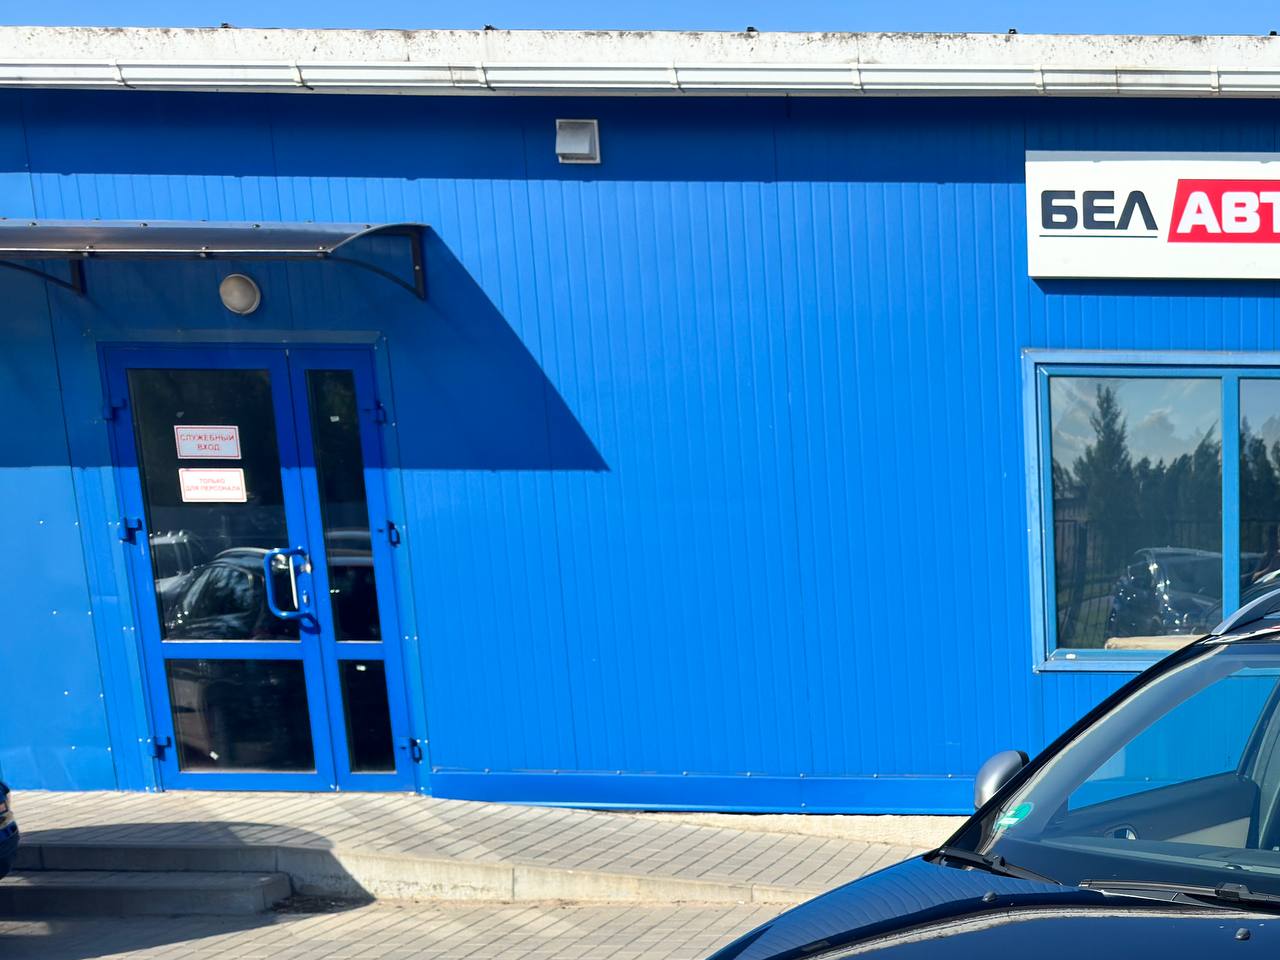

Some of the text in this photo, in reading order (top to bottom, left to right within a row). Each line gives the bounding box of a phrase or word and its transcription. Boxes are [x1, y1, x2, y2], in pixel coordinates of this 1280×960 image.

[1039, 189, 1159, 231] БЕЛ
[180, 434, 235, 442] СЛУЖЕБНЫЙ
[197, 443, 221, 451] ВХОД
